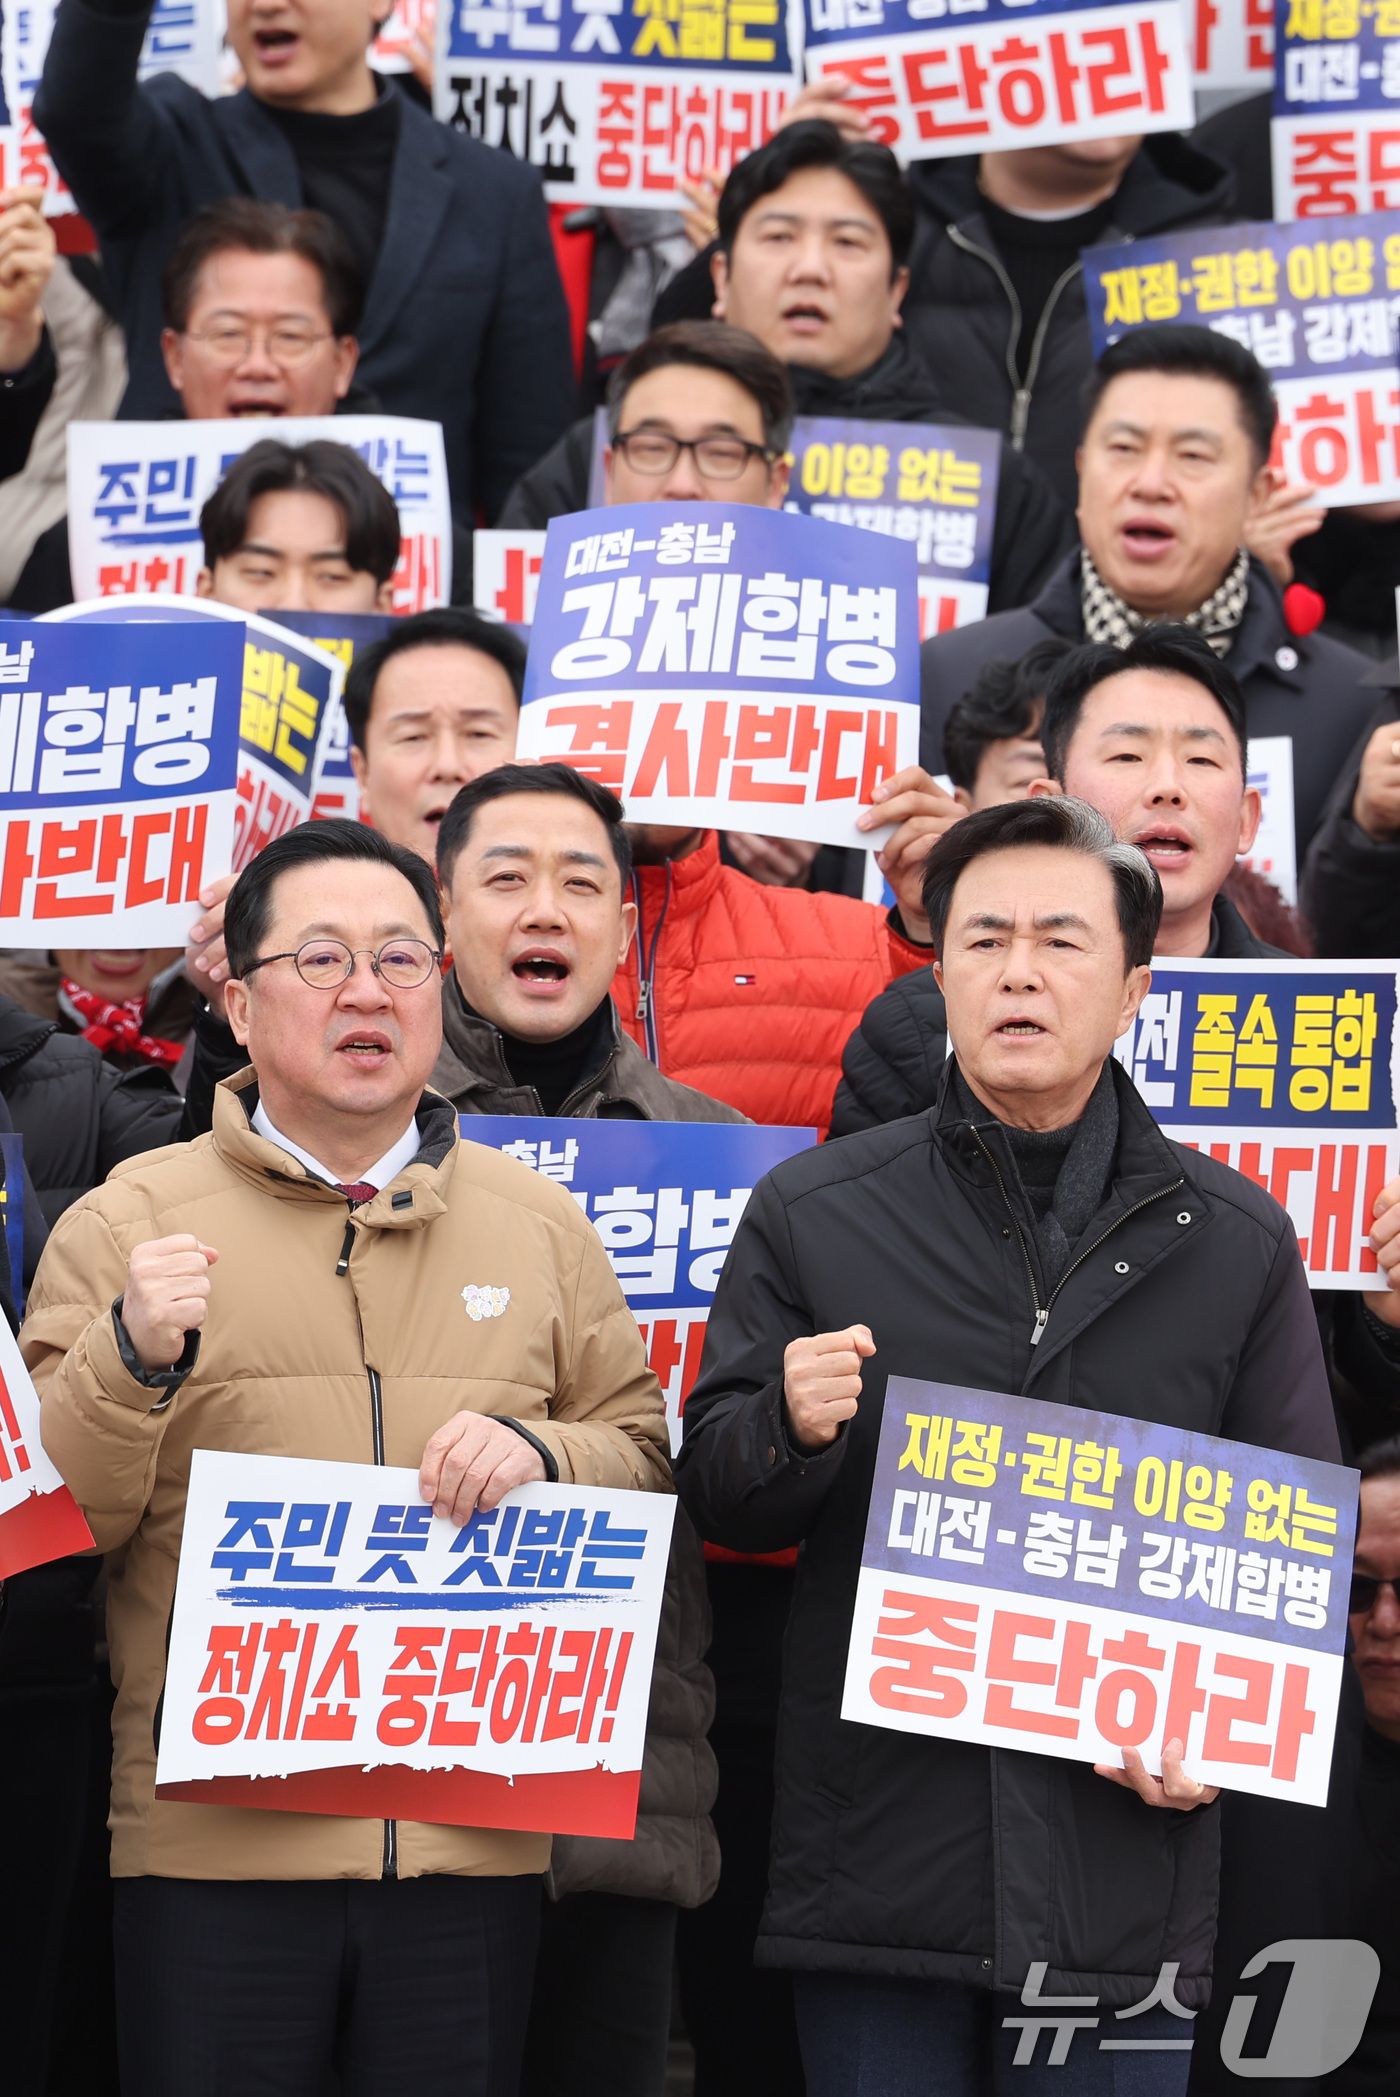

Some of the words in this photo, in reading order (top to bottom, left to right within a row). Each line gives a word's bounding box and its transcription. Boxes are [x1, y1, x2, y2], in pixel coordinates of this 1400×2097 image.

[1101, 248, 1278, 326] 재정·권한
[1287, 237, 1374, 301] 이양
[94, 456, 197, 527] 주민
[802, 442, 890, 499] 이양
[897, 447, 981, 508] 없는
[564, 522, 736, 579] 대전-충남
[550, 572, 898, 686] 강제합병
[537, 701, 899, 805] 결사반대
[1189, 993, 1279, 1109] 졸속
[1289, 989, 1378, 1112] 통합
[897, 1412, 1123, 1510] 재정·권한
[1133, 1456, 1234, 1532] 이양
[1244, 1478, 1338, 1557] 없는
[210, 1500, 353, 1584] 주민
[357, 1504, 434, 1585] 뜻
[440, 1506, 649, 1590] 짓밟는
[1138, 1531, 1332, 1631] 강제합병
[191, 1618, 361, 1747] 정치쇼
[376, 1621, 635, 1747] 중단하라!
[868, 1588, 1317, 1783] 중단하라
